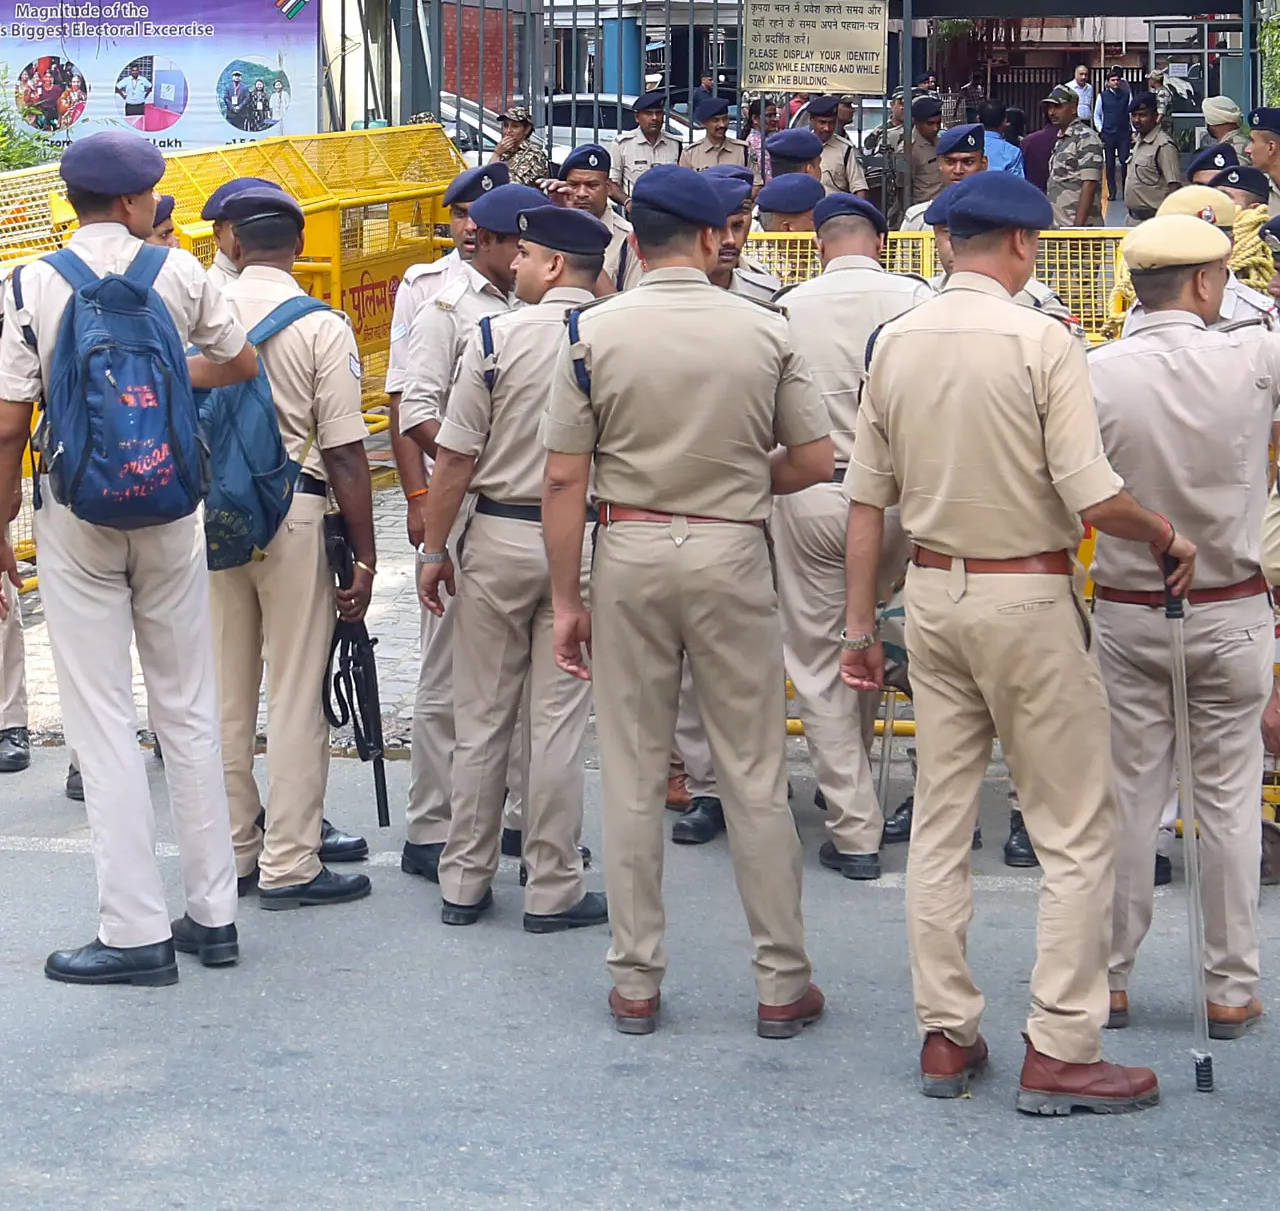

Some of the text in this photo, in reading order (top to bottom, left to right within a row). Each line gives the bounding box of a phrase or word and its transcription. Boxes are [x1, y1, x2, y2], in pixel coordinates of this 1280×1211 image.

[15, 3, 148, 21] Magnitude of the
[750, 3, 770, 15] कृपया
[804, 2, 821, 14] प्रवेश
[824, 2, 841, 14] करते
[846, 5, 864, 15] समय
[868, 4, 882, 16] और
[769, 17, 784, 29] रहने
[787, 18, 795, 28] के
[799, 20, 817, 29] समय
[820, 19, 838, 30] अपने
[841, 21, 879, 31] पहचान-पत्र
[11, 23, 69, 40] Biggest
[72, 22, 139, 37] Electoral
[143, 22, 214, 37] Excercise
[752, 32, 761, 43] को
[765, 32, 790, 44] प्रदर्शित
[749, 49, 880, 61] PLEASE DISPLAY YOUR IDENTITY
[749, 62, 880, 75] CARDS WHILE ENTERING AND WHILE
[748, 74, 830, 86] STAY IN THE BUILDING.
